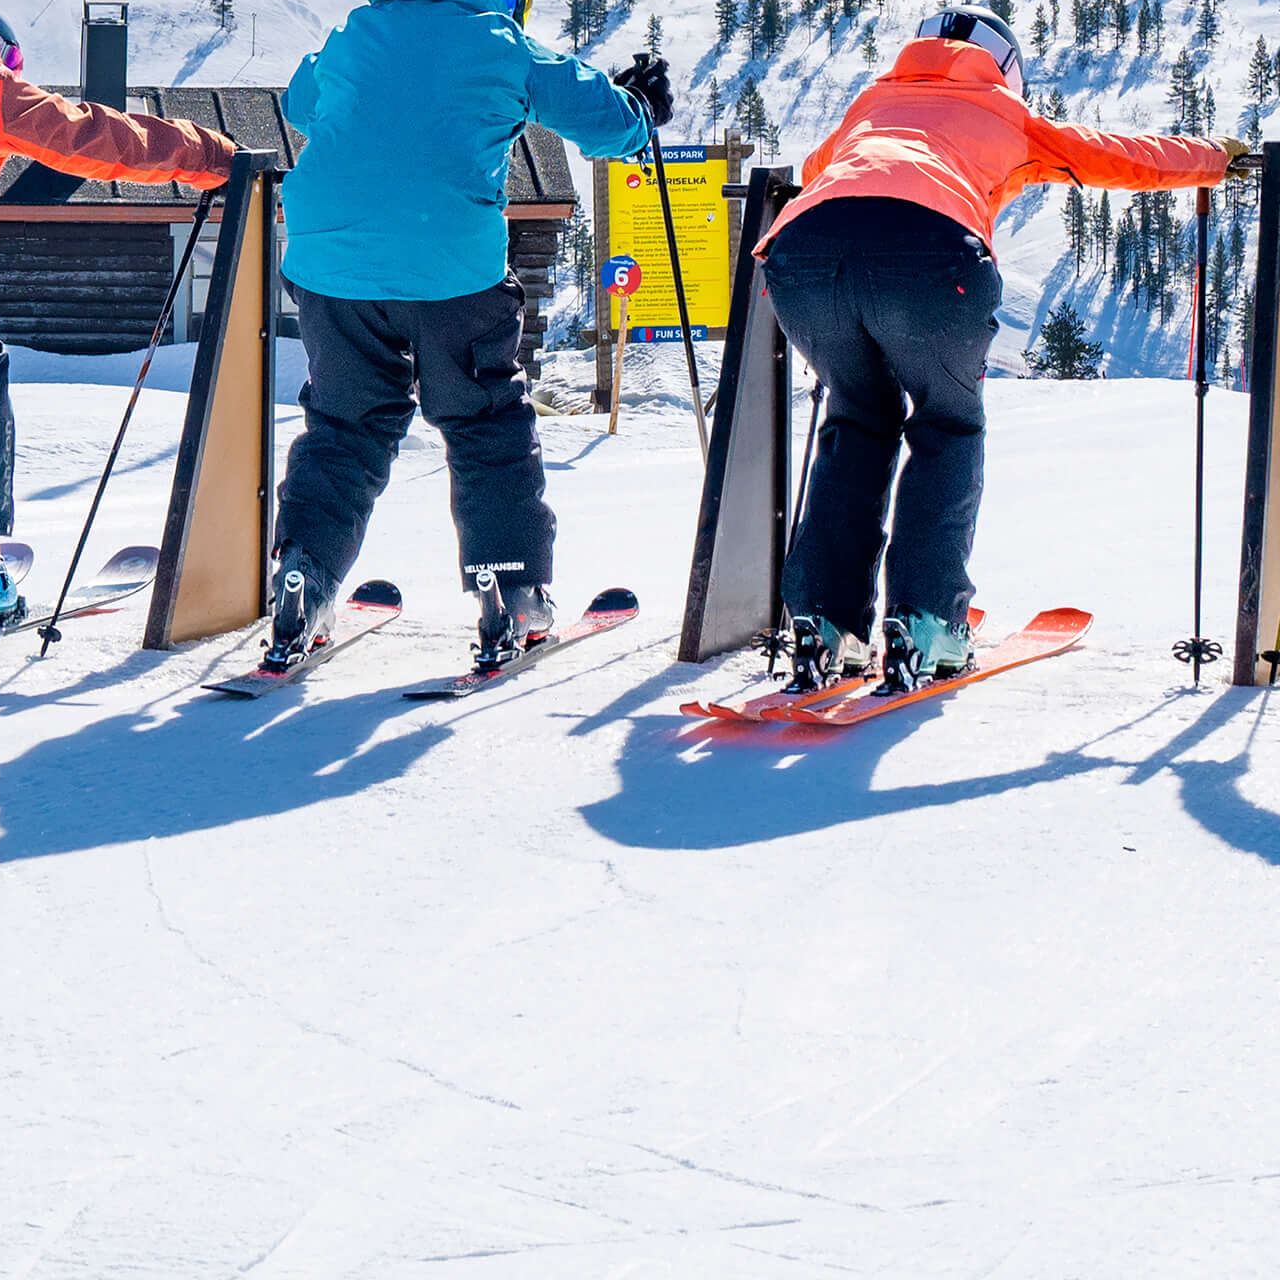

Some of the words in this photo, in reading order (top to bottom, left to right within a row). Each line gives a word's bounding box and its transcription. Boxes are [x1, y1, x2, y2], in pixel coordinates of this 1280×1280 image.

[680, 151, 704, 159] PARK
[646, 175, 707, 186] SARISELKÄ
[615, 266, 629, 287] 6
[655, 329, 674, 339] FUN
[674, 329, 702, 338] SLPE
[486, 561, 525, 572] HANSEN
